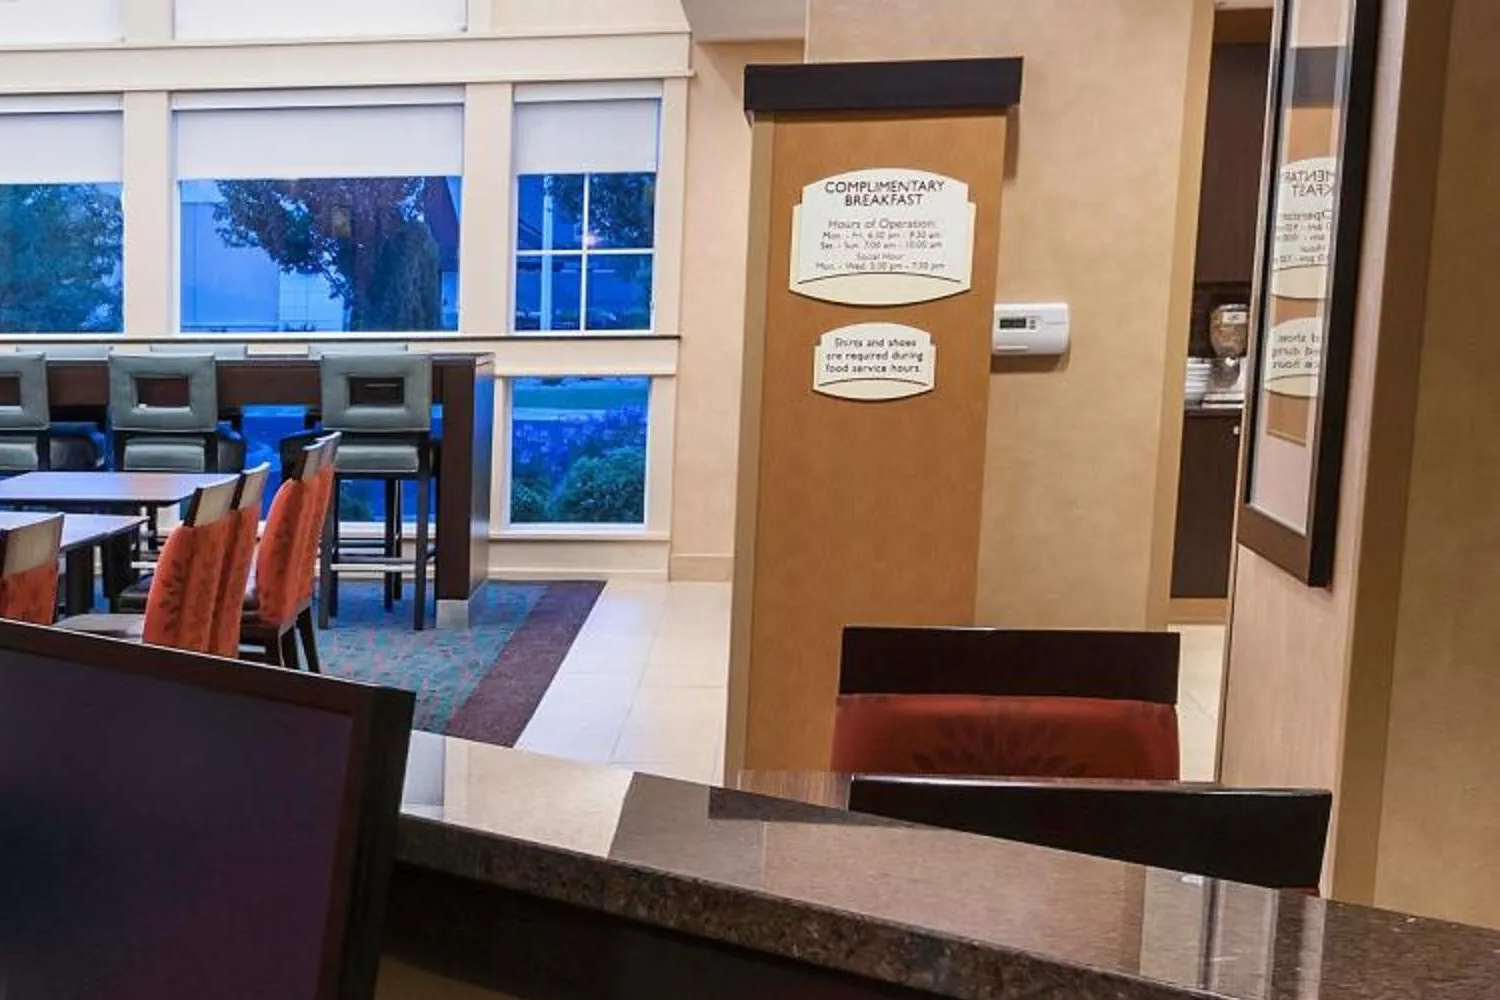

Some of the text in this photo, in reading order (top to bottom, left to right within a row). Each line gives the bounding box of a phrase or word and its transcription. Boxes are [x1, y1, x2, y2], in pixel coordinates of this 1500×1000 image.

[824, 181, 945, 193] COMPLIMENTARY
[845, 194, 923, 206] BREAKFAST
[828, 219, 860, 229] Hours
[864, 217, 876, 229] of
[867, 338, 884, 347] and
[888, 338, 917, 347] shoes
[826, 351, 923, 362] are required during
[825, 364, 849, 373] food
[851, 364, 887, 373] service
